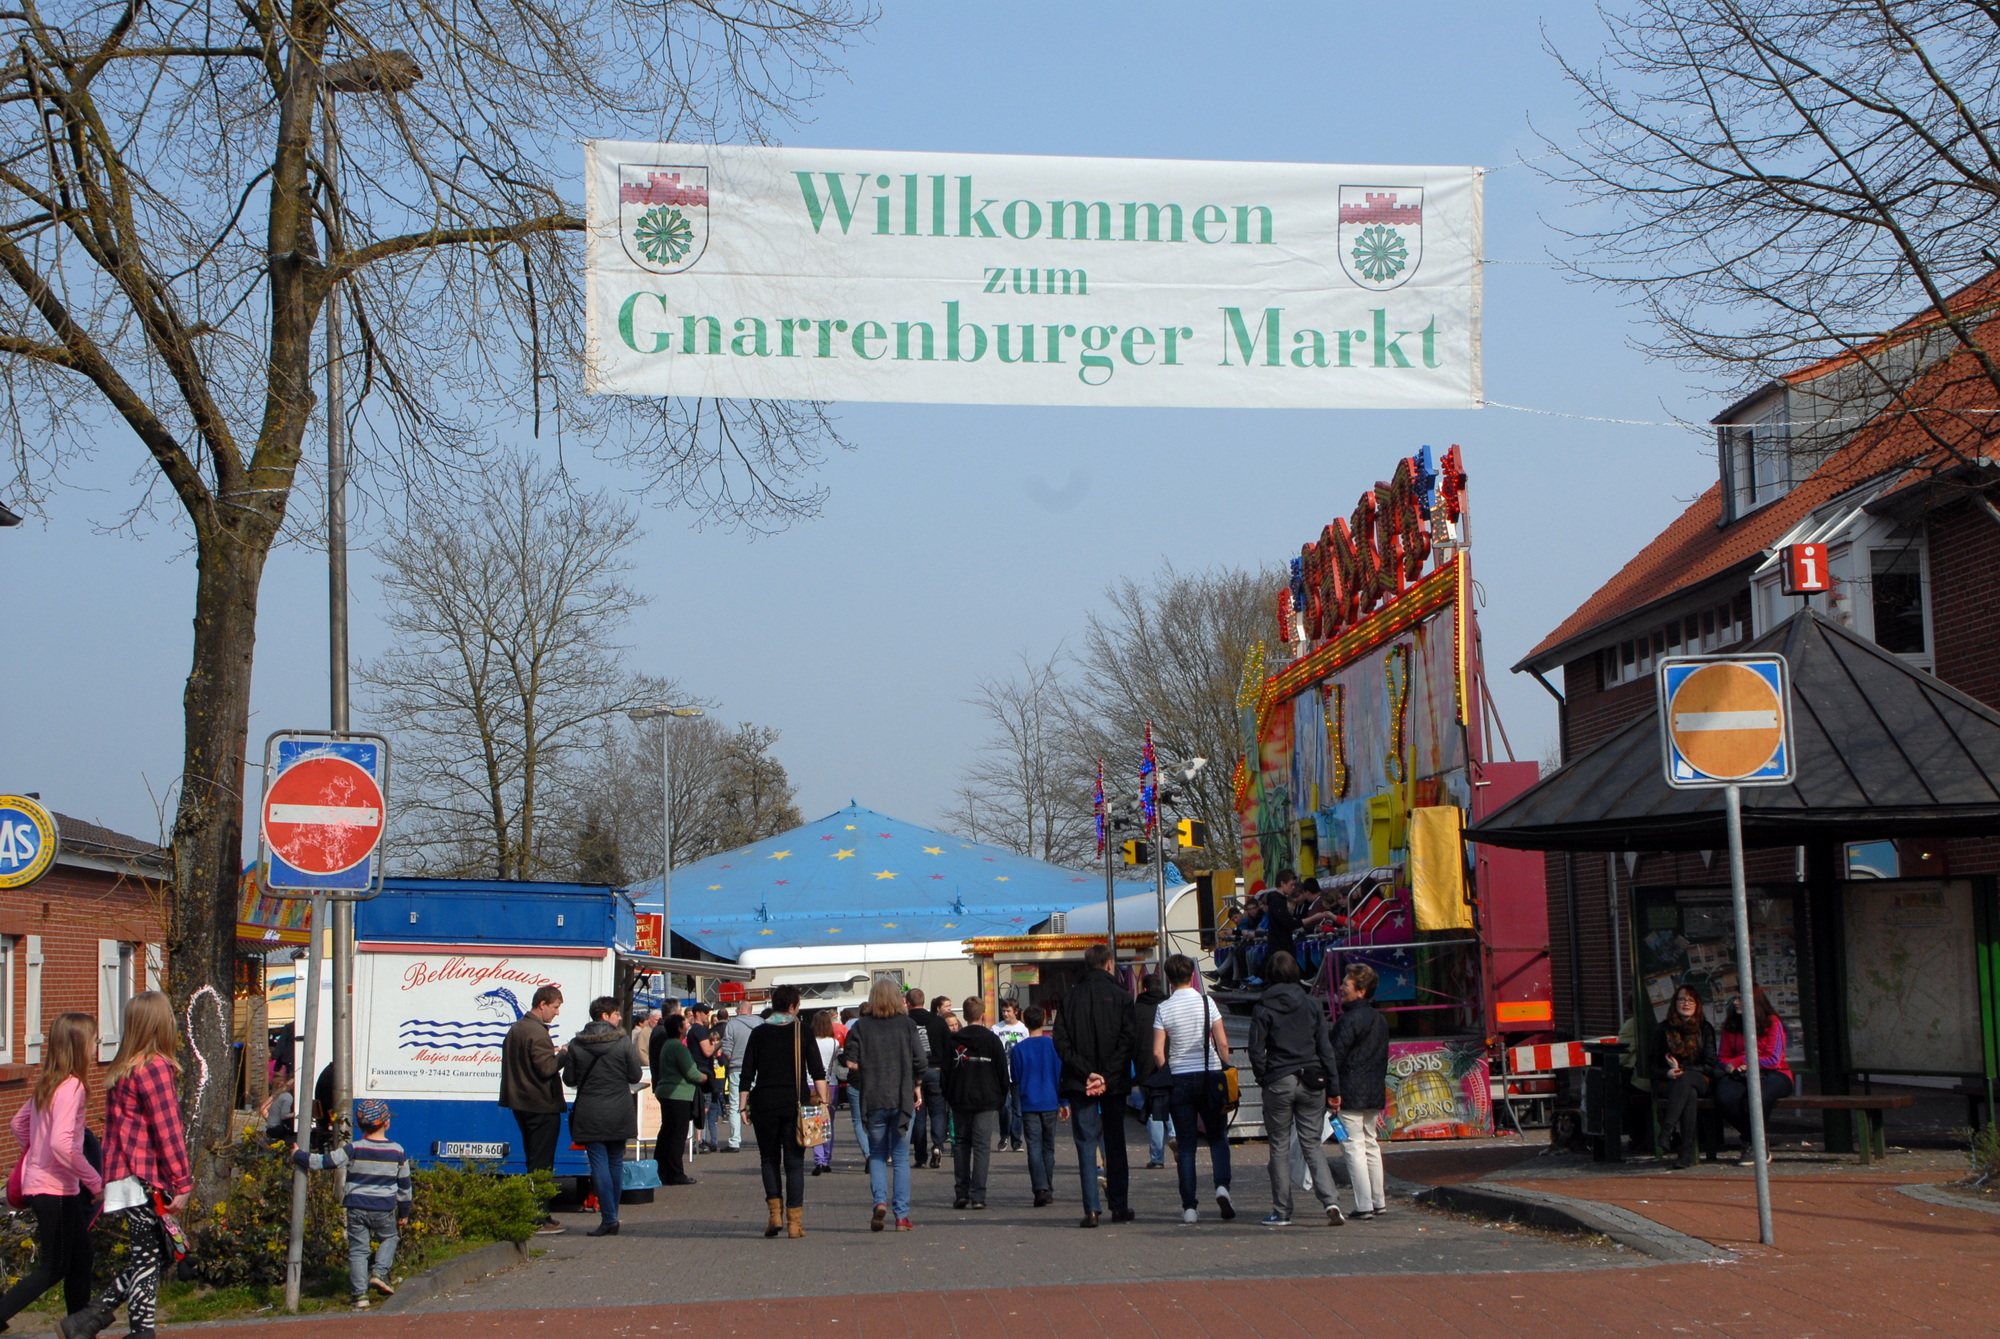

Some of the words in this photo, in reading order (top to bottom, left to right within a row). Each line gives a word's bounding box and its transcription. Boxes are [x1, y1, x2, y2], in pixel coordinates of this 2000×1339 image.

[790, 170, 1278, 245] Willkommen
[983, 266, 1090, 295] zum
[617, 291, 1194, 386] Gnarrenburger
[1218, 306, 1443, 369] Markt
[0, 820, 35, 868] AS
[411, 1049, 449, 1064] Matjes
[450, 1050, 478, 1062] nach
[477, 1050, 502, 1066] fein
[1396, 1053, 1442, 1077] OASIS
[371, 1067, 418, 1077] Fasanenweg
[1405, 1099, 1454, 1120] CASINO
[447, 1143, 465, 1154] ROW
[471, 1144, 483, 1154] MB
